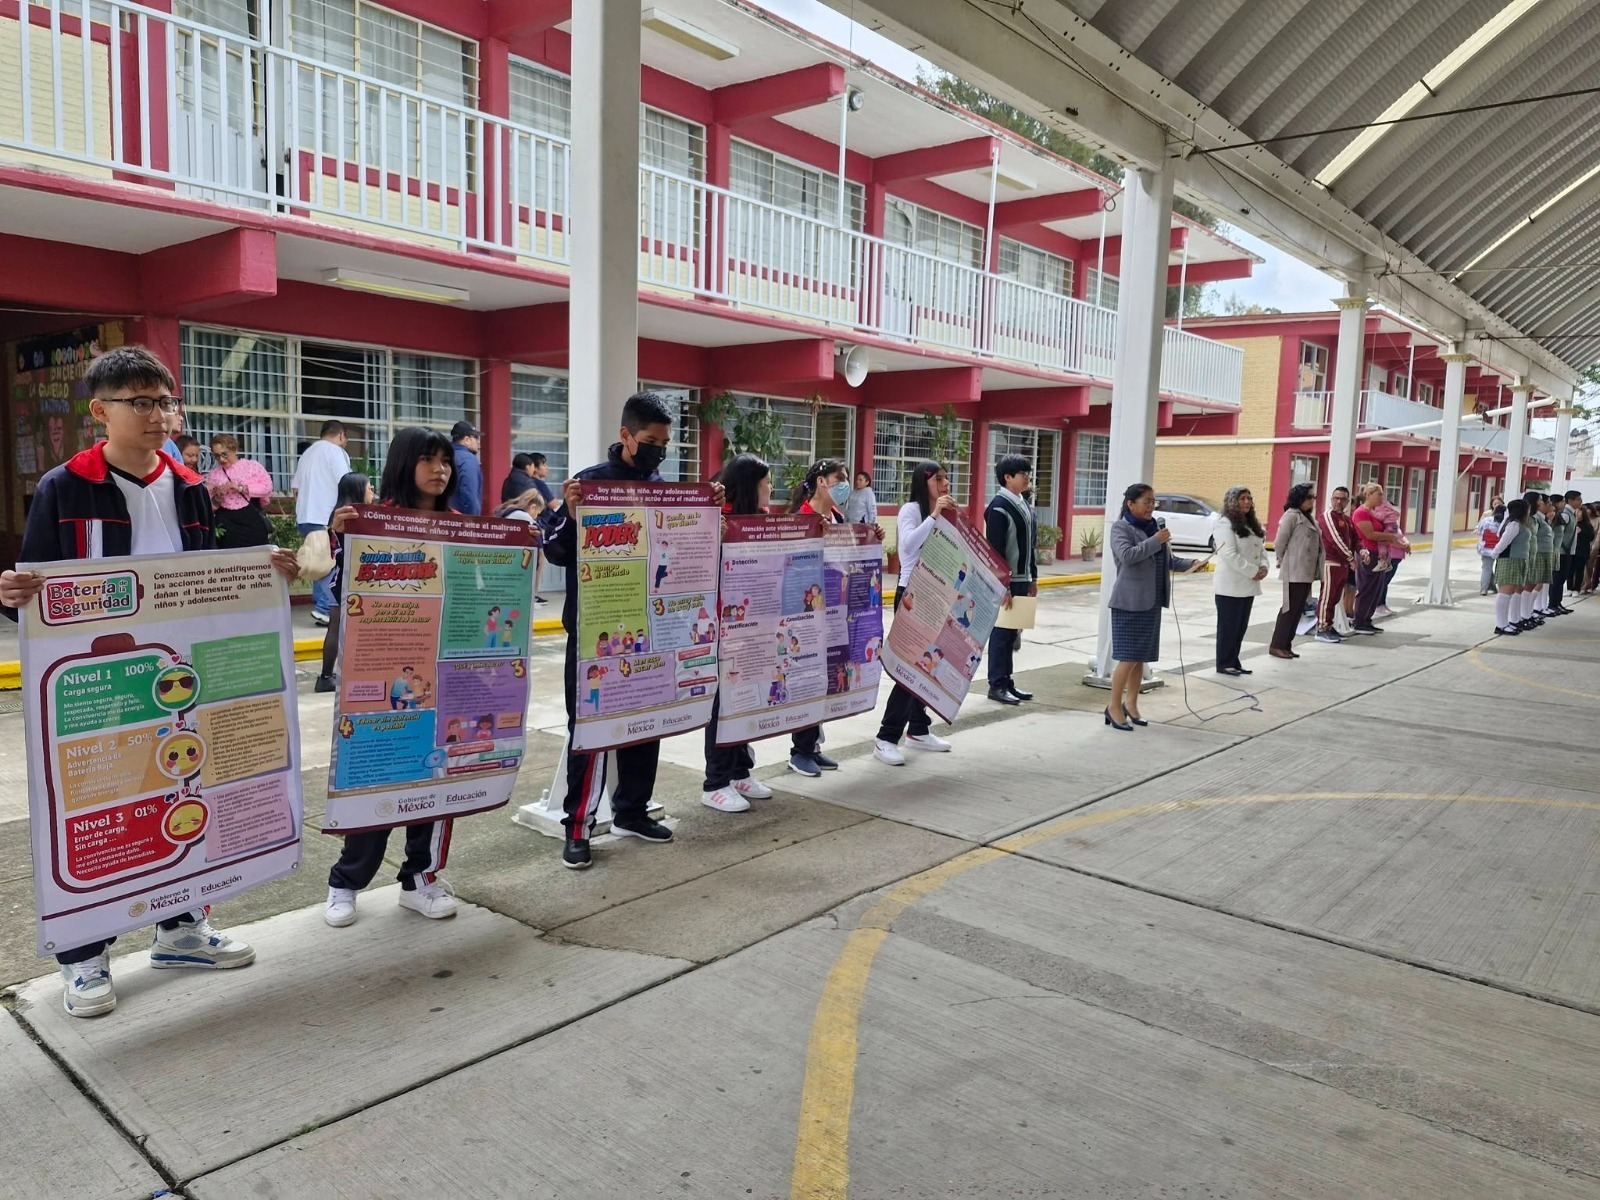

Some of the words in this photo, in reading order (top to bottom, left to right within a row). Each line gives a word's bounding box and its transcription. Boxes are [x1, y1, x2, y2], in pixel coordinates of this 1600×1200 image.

[597, 486, 609, 495] Soy
[363, 511, 392, 520] ¿Cómo
[393, 515, 430, 524] reconocer
[438, 520, 463, 528] actuar
[491, 523, 521, 532] maltrato
[654, 510, 663, 529] 1
[384, 522, 405, 531] hacia
[458, 530, 506, 539] adolescentes?
[360, 553, 392, 563] CUIDAR
[154, 570, 206, 580] Conozcamos
[214, 564, 272, 574] identifiquemos
[581, 563, 592, 582] 2
[168, 578, 204, 588] acciones
[220, 574, 255, 582] maltrato
[50, 580, 116, 600] Batería
[154, 591, 178, 599] dañan
[194, 585, 232, 595] bienestar
[250, 580, 272, 589] niñas,
[51, 594, 130, 616] Seguridad
[154, 600, 178, 610] niños
[188, 594, 241, 604] adolescentes.
[347, 594, 364, 617] 2
[652, 598, 665, 616] 3
[727, 621, 758, 630] Notificación
[63, 670, 100, 686] Nivel
[105, 670, 112, 679] 1
[124, 662, 154, 676] 100%
[510, 658, 526, 678] 3
[619, 659, 632, 678] 4
[64, 688, 86, 696] Carga
[86, 684, 112, 694] segura
[72, 711, 106, 721] convivencia
[662, 714, 692, 725] Educación
[338, 715, 354, 739] 4
[627, 724, 655, 736] México
[66, 742, 104, 759] Nivel
[109, 740, 117, 750] 2
[127, 733, 153, 746] 50%
[67, 755, 112, 769] Advertencia
[398, 795, 427, 804] Gobierno
[446, 790, 487, 802] Educación
[397, 800, 435, 814] México
[73, 814, 111, 834] Nivel
[115, 812, 124, 823] 3
[134, 804, 157, 817] 01%
[74, 834, 93, 844] Error
[74, 843, 86, 852] Sin
[87, 838, 108, 847] carga
[84, 847, 116, 860] convivencia
[76, 866, 101, 875] Necesito
[102, 860, 119, 868] ayuda
[201, 875, 242, 893] Educación
[150, 890, 181, 903] Gobierno
[150, 894, 190, 911] México
